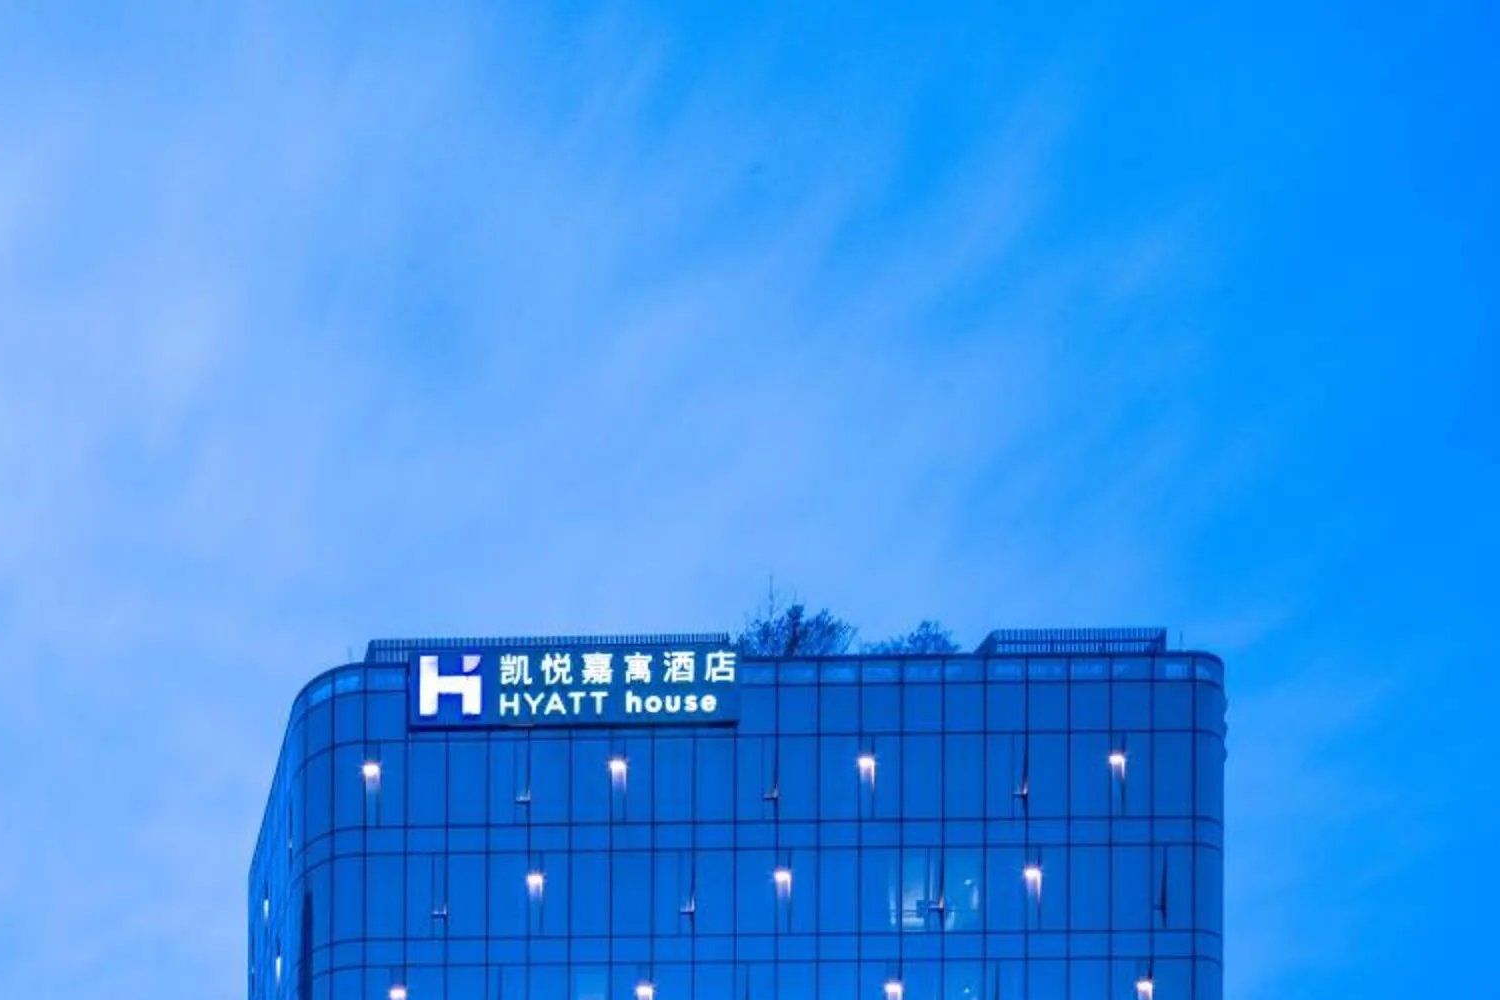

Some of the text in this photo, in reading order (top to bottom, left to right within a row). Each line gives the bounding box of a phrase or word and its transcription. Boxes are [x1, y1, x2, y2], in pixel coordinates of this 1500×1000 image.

[499, 650, 737, 685] 凯悦嘉寓酒店
[499, 690, 717, 716] HYATT house
